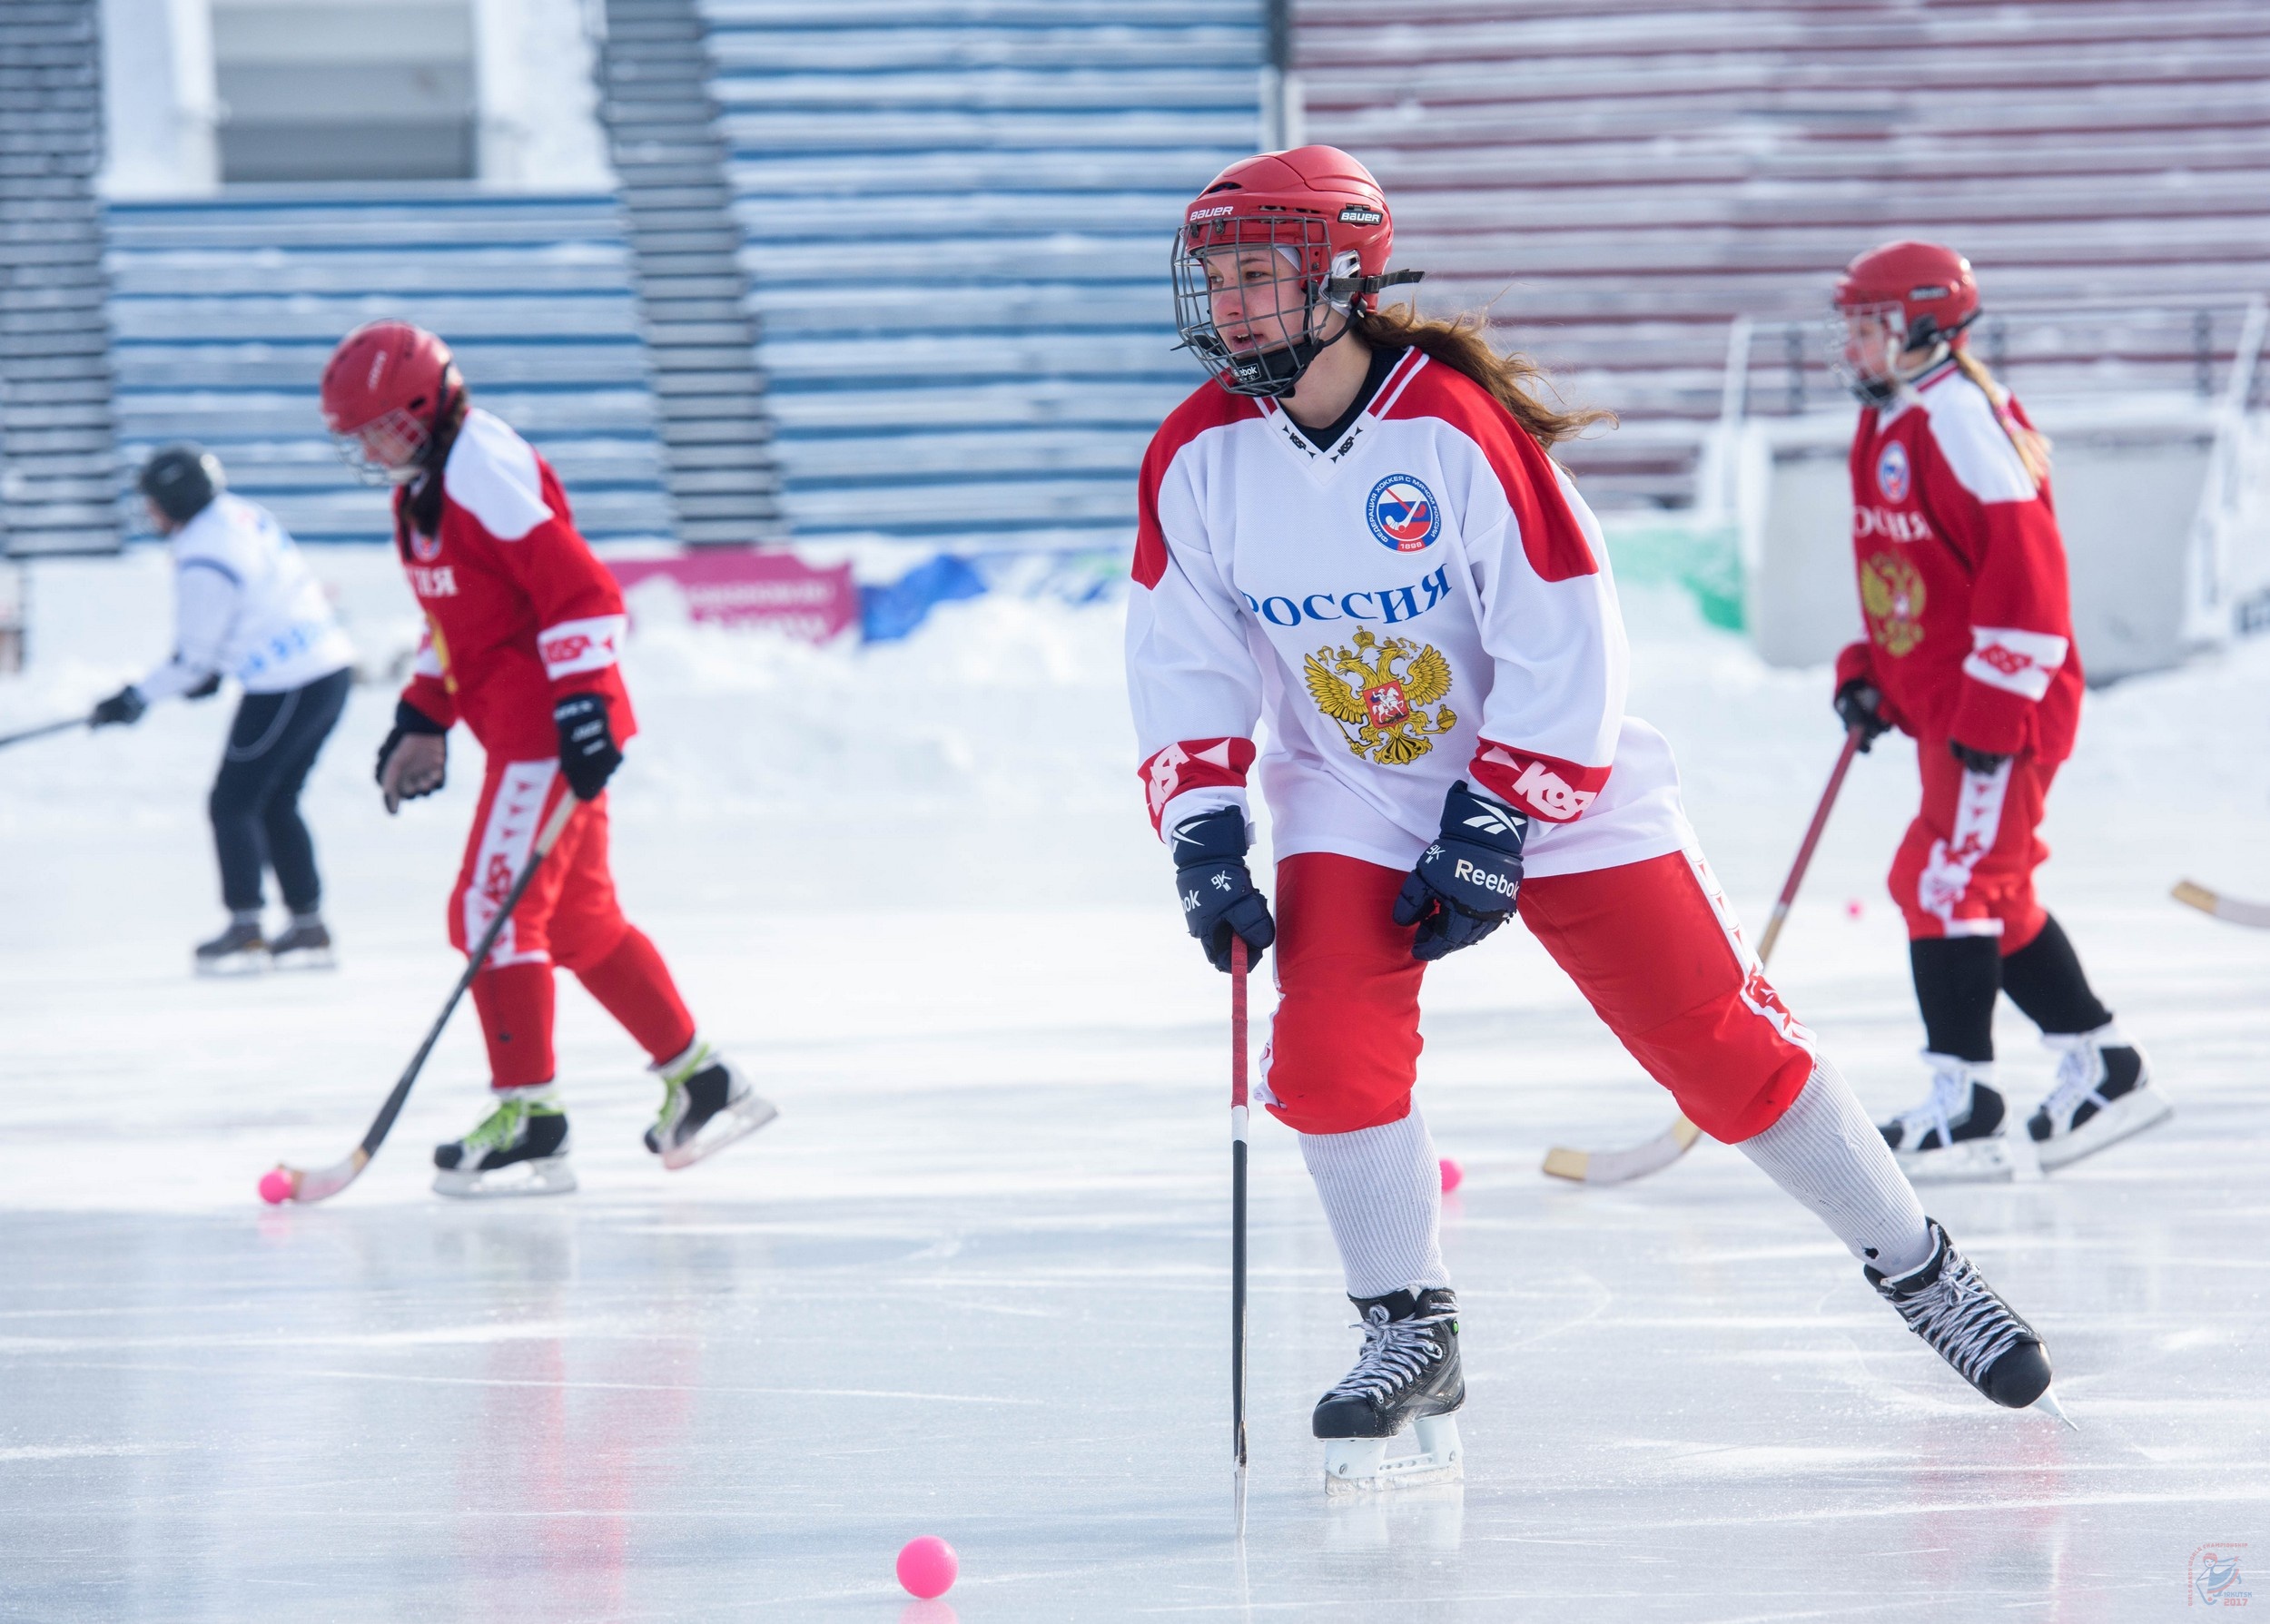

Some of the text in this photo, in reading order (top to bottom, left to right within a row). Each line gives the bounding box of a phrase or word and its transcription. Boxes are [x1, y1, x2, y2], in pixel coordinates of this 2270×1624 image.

[1189, 205, 1234, 221] BAUER
[1340, 212, 1381, 222] BAUER
[1375, 476, 1405, 493] ХОККЕЯ
[1412, 479, 1436, 505] МЯЧОМ
[1368, 492, 1388, 543] ФЕДЕРАЦИЯ
[1430, 506, 1440, 537] РОССИИ
[1400, 541, 1423, 549] 1898
[1426, 844, 1446, 861] 9K
[1210, 870, 1232, 890] 9K
[1455, 858, 1520, 901] Reebok
